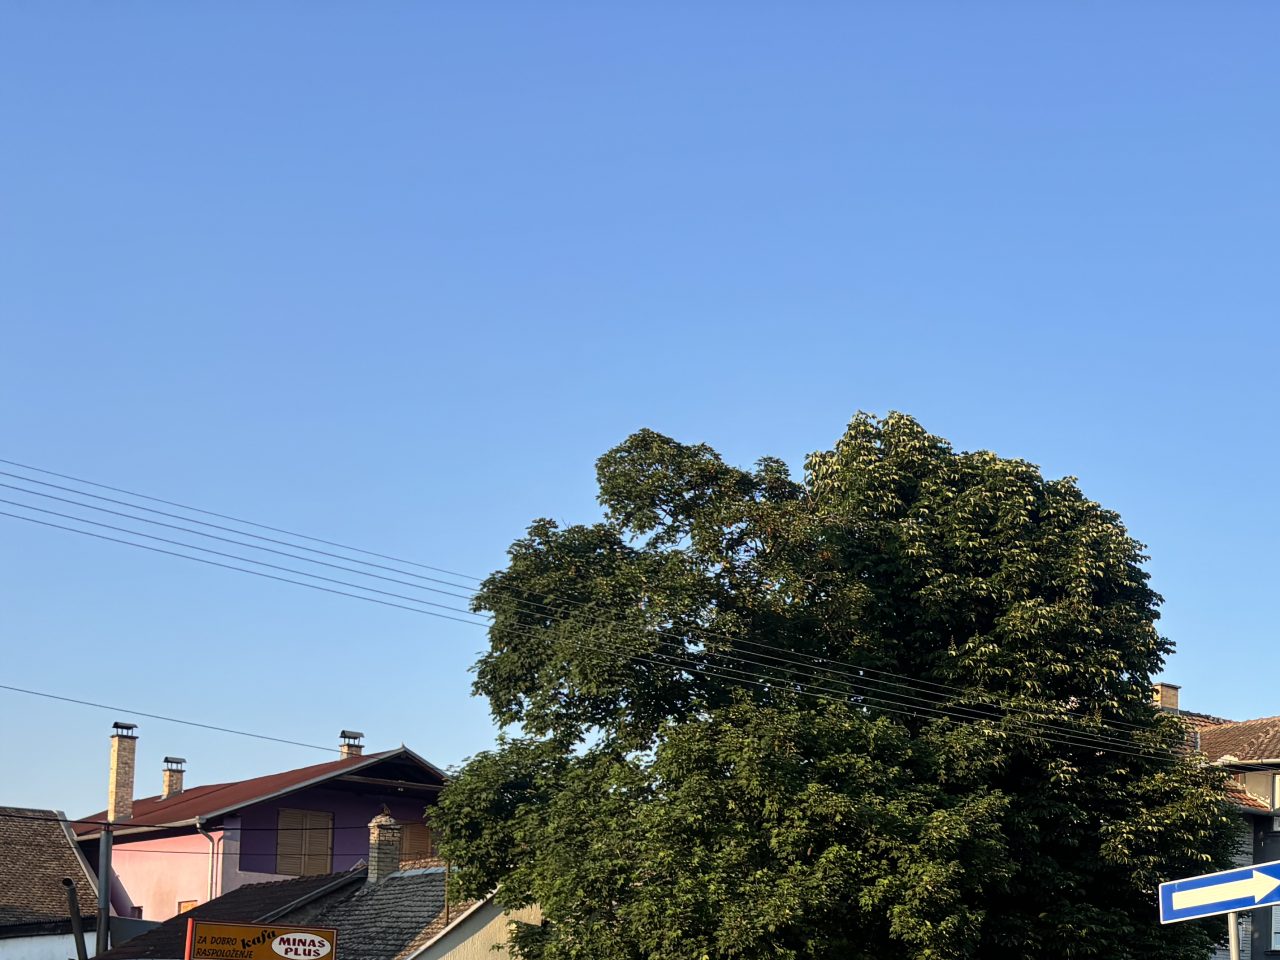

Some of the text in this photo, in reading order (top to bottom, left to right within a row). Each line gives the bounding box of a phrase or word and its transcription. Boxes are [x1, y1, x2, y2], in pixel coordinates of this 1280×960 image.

[197, 935, 237, 946] ZA DOBRO
[240, 929, 277, 950] kafa
[278, 936, 326, 948] MINAS
[196, 947, 253, 959] RASPOLOŽENJE
[284, 947, 321, 957] PLUS
